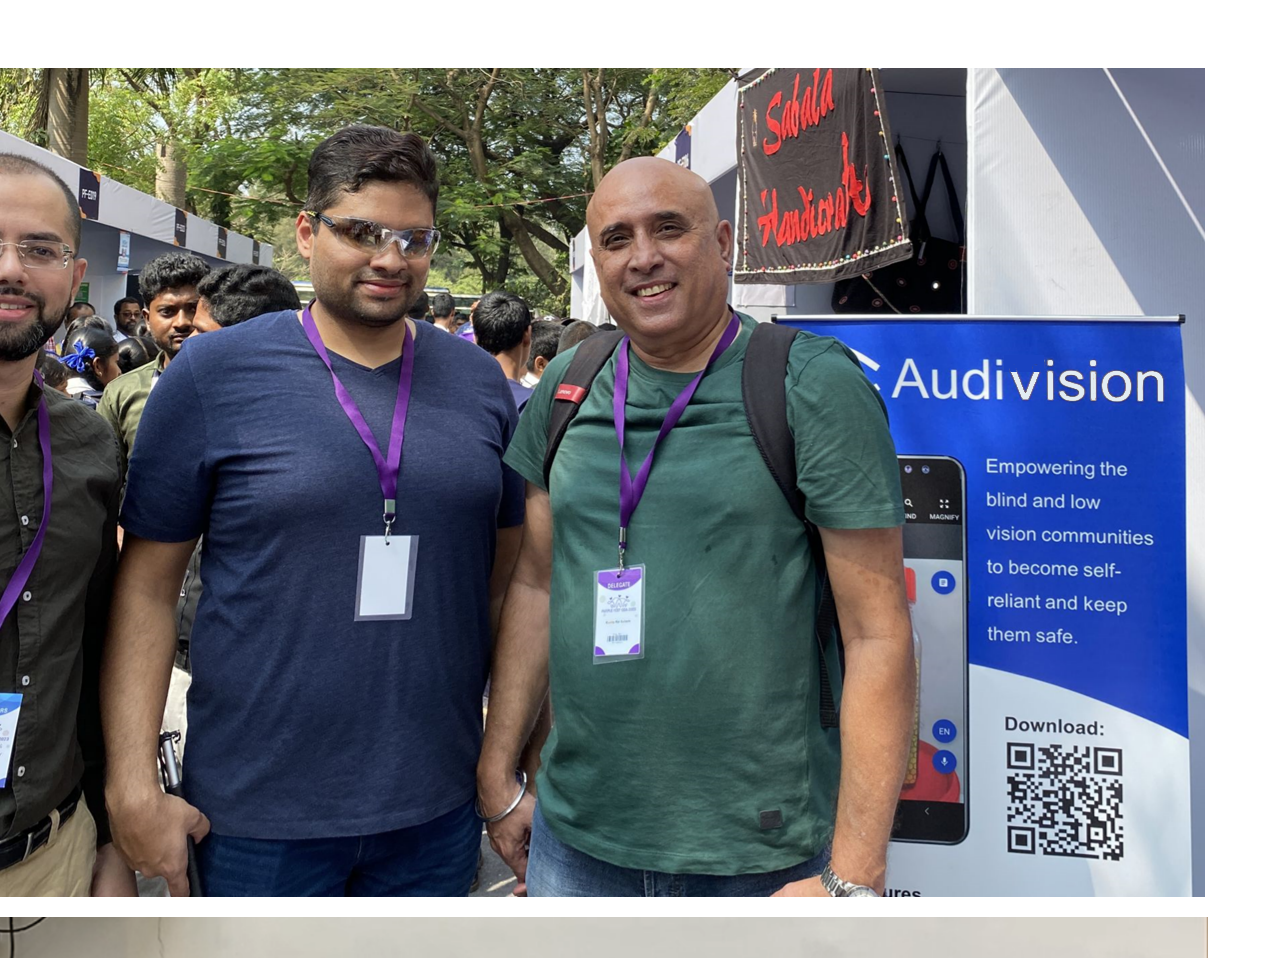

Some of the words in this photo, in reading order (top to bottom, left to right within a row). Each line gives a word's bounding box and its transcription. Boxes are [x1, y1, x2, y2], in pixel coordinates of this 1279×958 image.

[762, 68, 835, 156] Sabala
[891, 357, 1165, 403] Audivision
[985, 458, 1096, 480] Empowering
[1100, 461, 1128, 477] the
[986, 491, 1028, 508] blind
[1032, 494, 1066, 509] and
[1071, 494, 1101, 510] low
[929, 513, 960, 521] MAGNIFY
[986, 525, 1037, 542] vision
[1041, 529, 1155, 546] communities
[987, 559, 1004, 575] to
[1008, 559, 1079, 577] become
[1083, 562, 1122, 578] self-
[607, 581, 631, 589] DELEGATE
[987, 593, 1041, 609] reliant
[1045, 595, 1078, 611] and
[1083, 596, 1128, 616] keep
[987, 626, 1031, 642] them
[1035, 628, 1079, 645] safe.
[938, 727, 950, 736] EN
[1004, 716, 1105, 736] Download:
